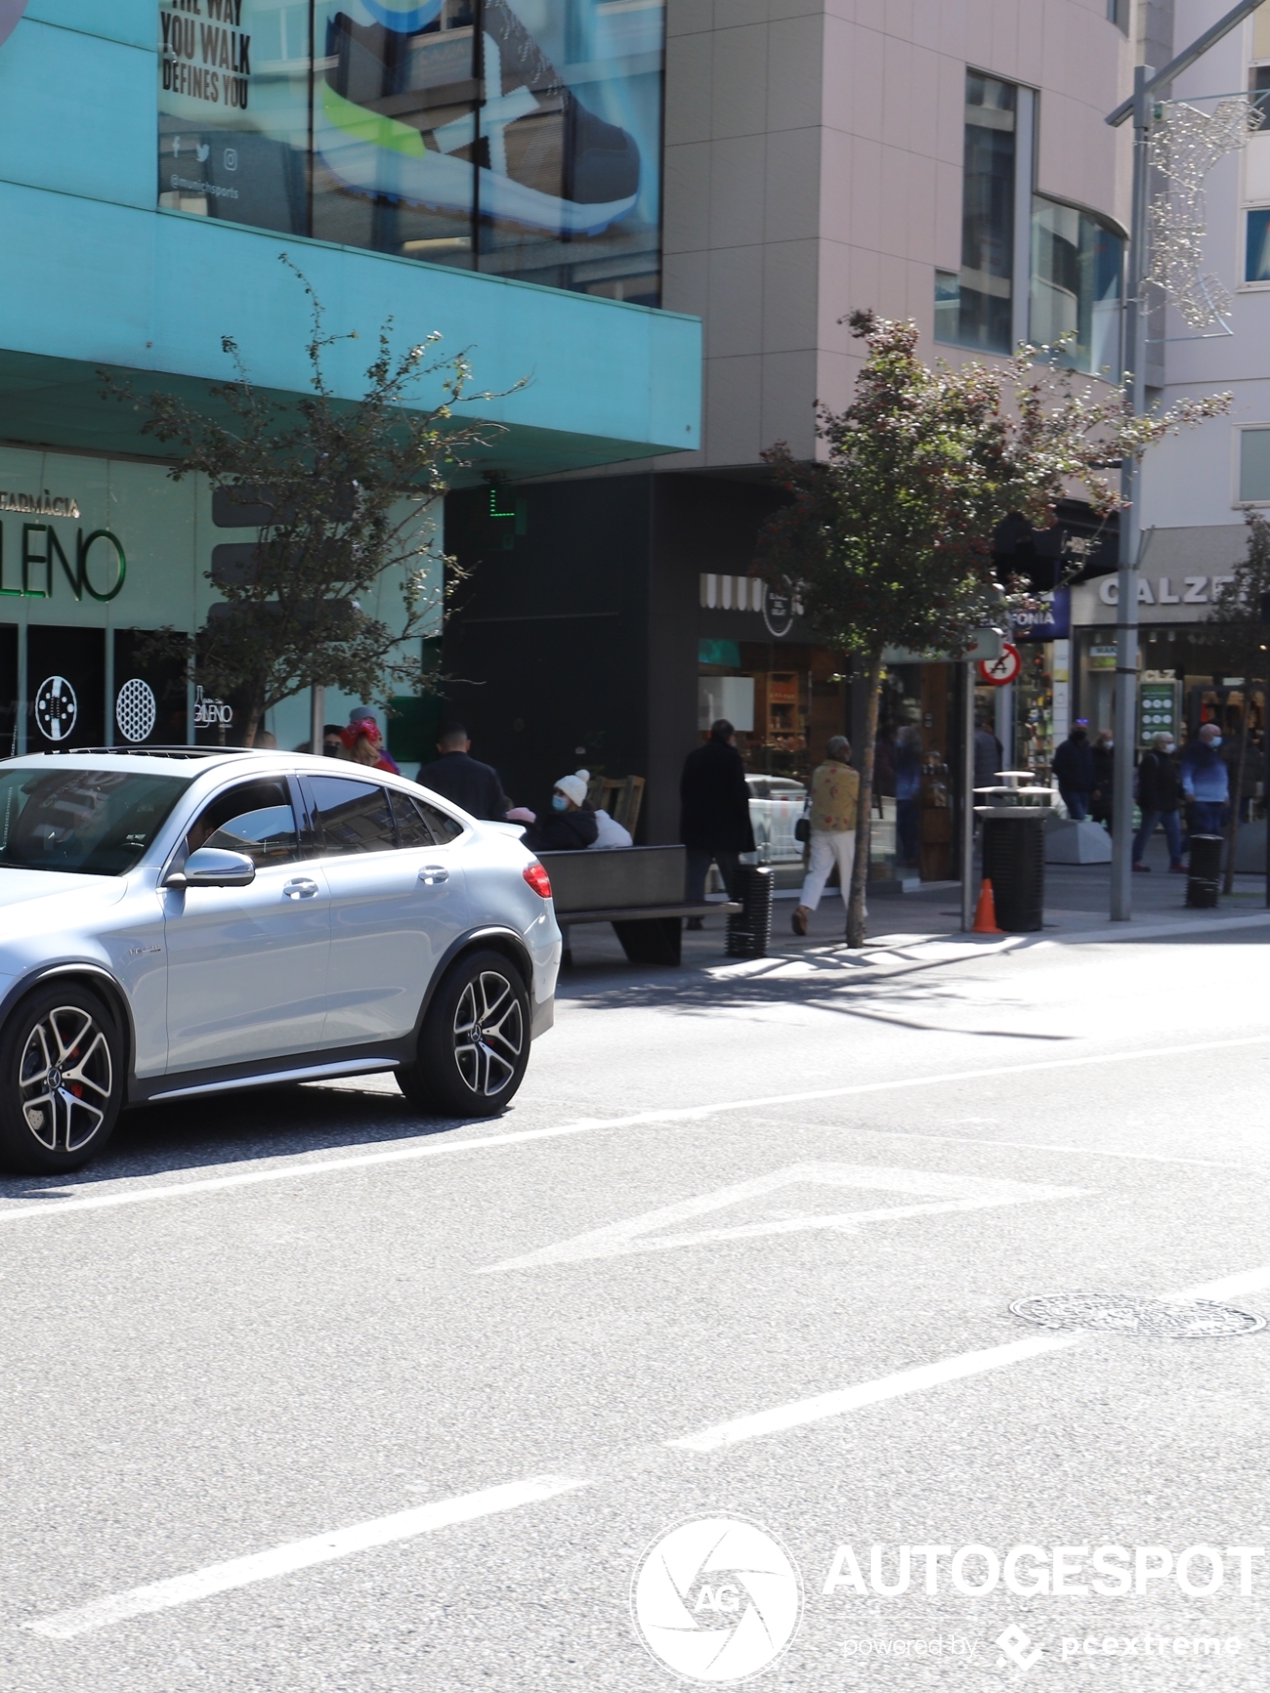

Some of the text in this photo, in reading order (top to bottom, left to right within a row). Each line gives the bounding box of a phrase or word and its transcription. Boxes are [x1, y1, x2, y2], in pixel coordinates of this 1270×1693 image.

[160, 11, 251, 76] YOU WALK
[162, 58, 248, 110] DEFINES YOU
